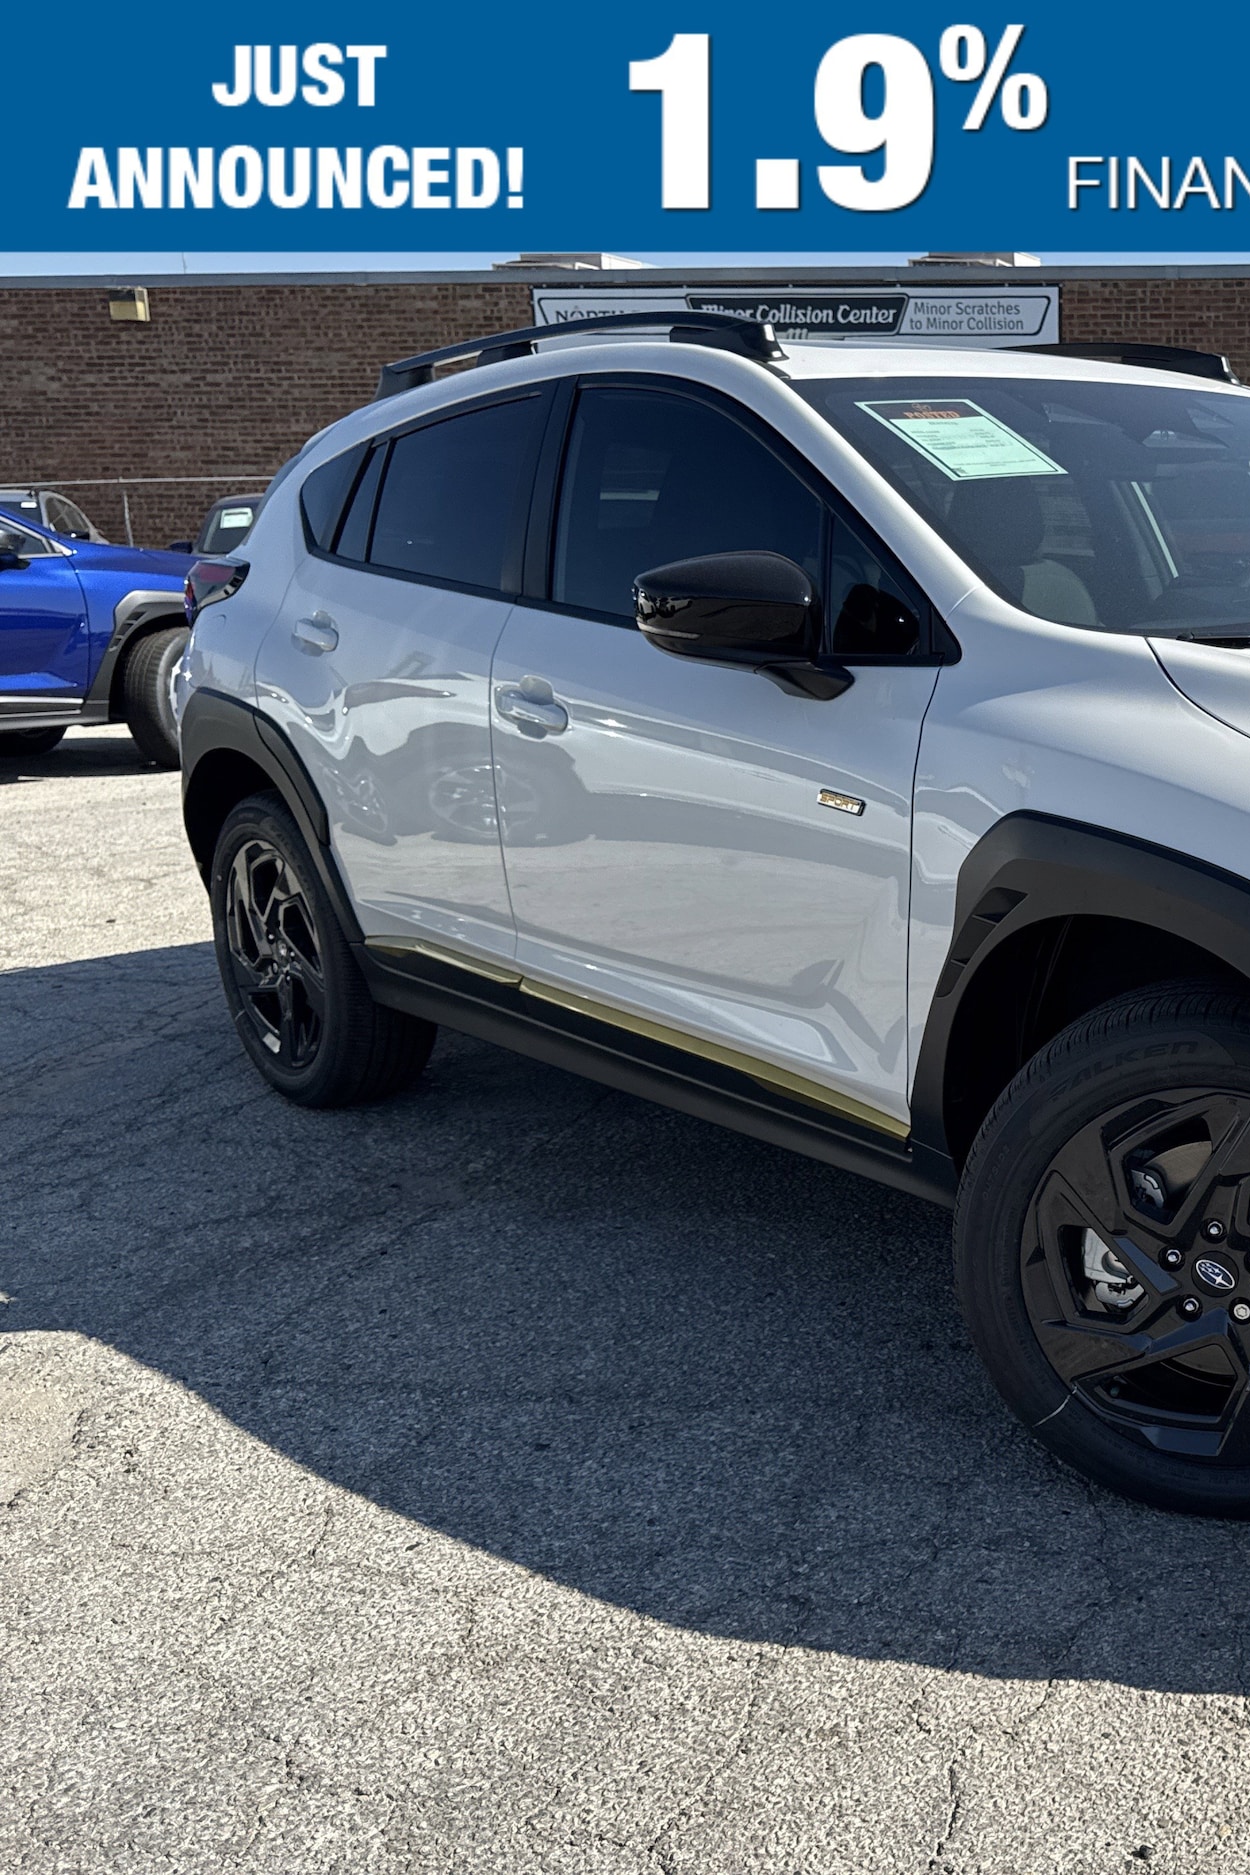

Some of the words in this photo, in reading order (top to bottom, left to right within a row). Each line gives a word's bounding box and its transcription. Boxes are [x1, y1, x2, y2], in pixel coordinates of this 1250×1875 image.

[756, 304, 835, 323] Collision
[837, 304, 897, 324] Center
[914, 302, 951, 315] Minor
[955, 302, 1021, 315] Scratches
[910, 318, 923, 330] to
[926, 318, 964, 330] Minor
[967, 317, 1024, 330] Collision
[820, 791, 861, 812] SPORT
